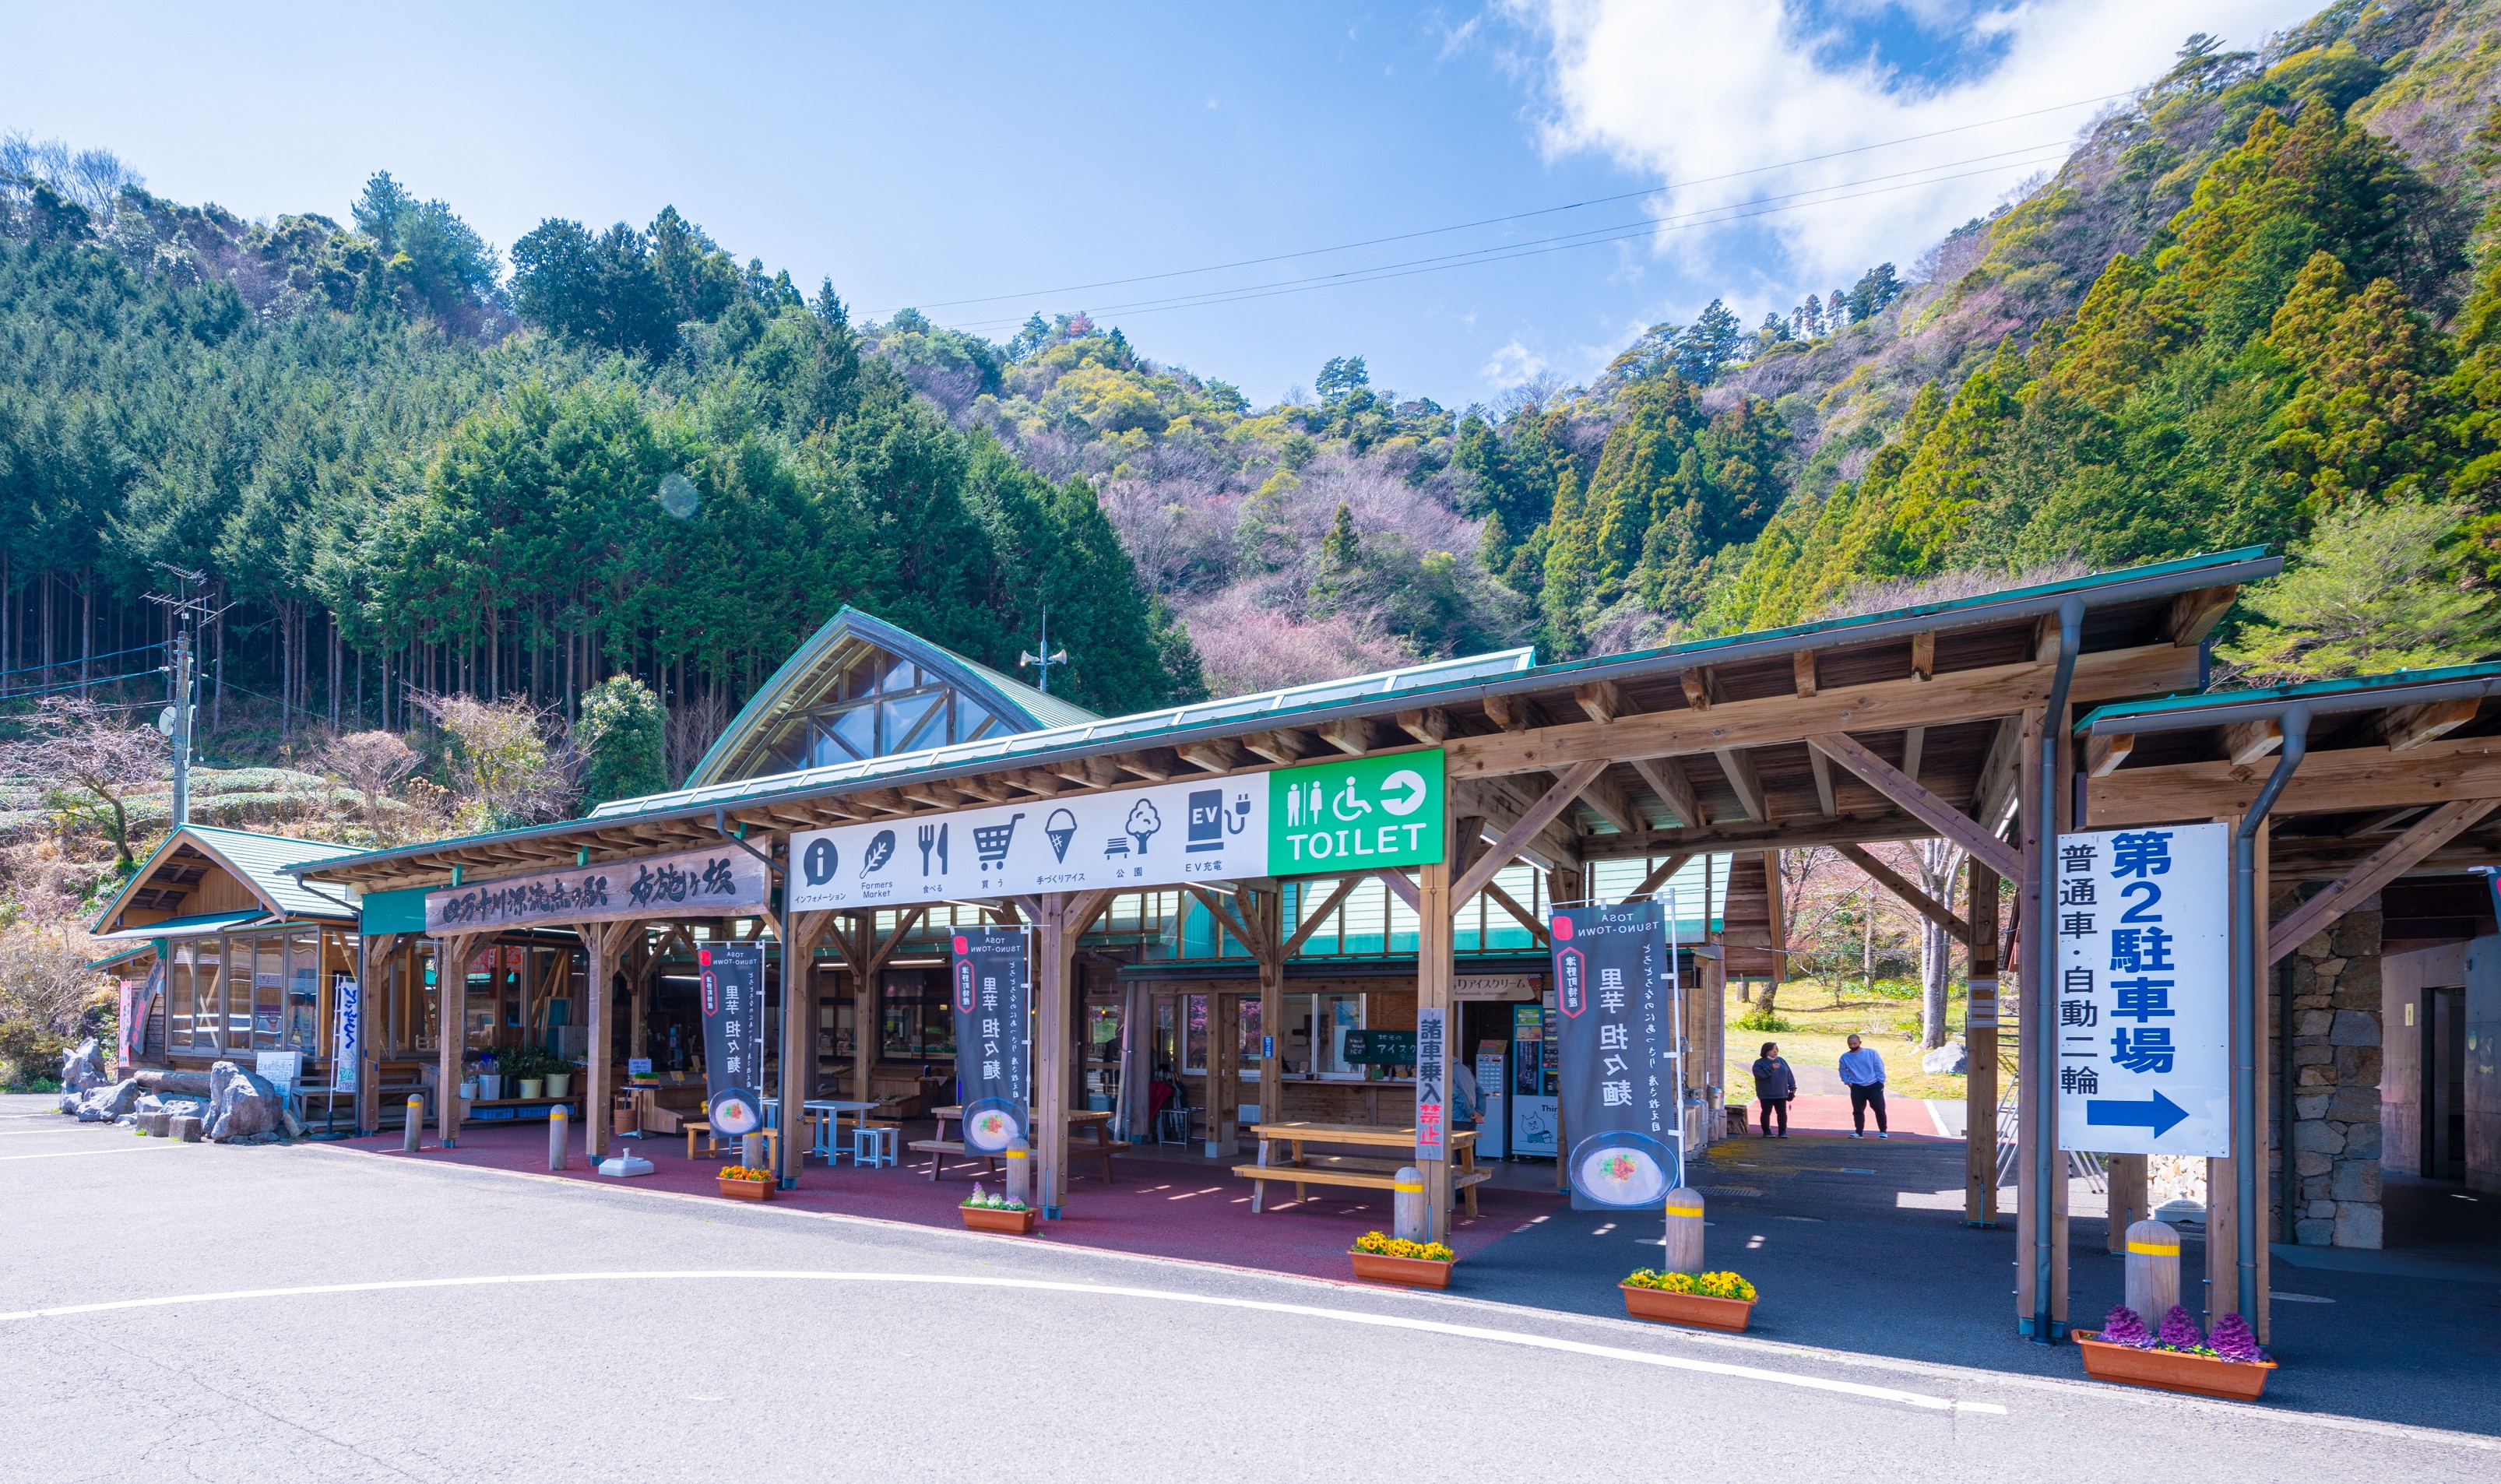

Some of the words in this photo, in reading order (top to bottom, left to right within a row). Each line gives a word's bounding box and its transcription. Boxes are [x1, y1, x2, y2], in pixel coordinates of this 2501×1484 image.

[1192, 806, 1218, 825] EV
[1286, 823, 1427, 861] TOILET
[1185, 860, 1222, 872] EV充電
[1116, 867, 1142, 878] 公園
[981, 879, 1003, 889] 買う
[1036, 873, 1085, 885] 手づくりアイス
[861, 881, 893, 890] Farmers
[922, 884, 943, 894] 食べる
[442, 875, 608, 923] 四万十川源流点の駅
[794, 892, 846, 904] インフォメーション
[863, 889, 891, 898] Market
[2108, 829, 2176, 1074] 第2駐車場
[2059, 843, 2099, 1095] 普通車・自動二輪
[1454, 979, 1526, 991] りアイスクリーム
[1419, 1018, 1443, 1148] 諸車乗入禁止
